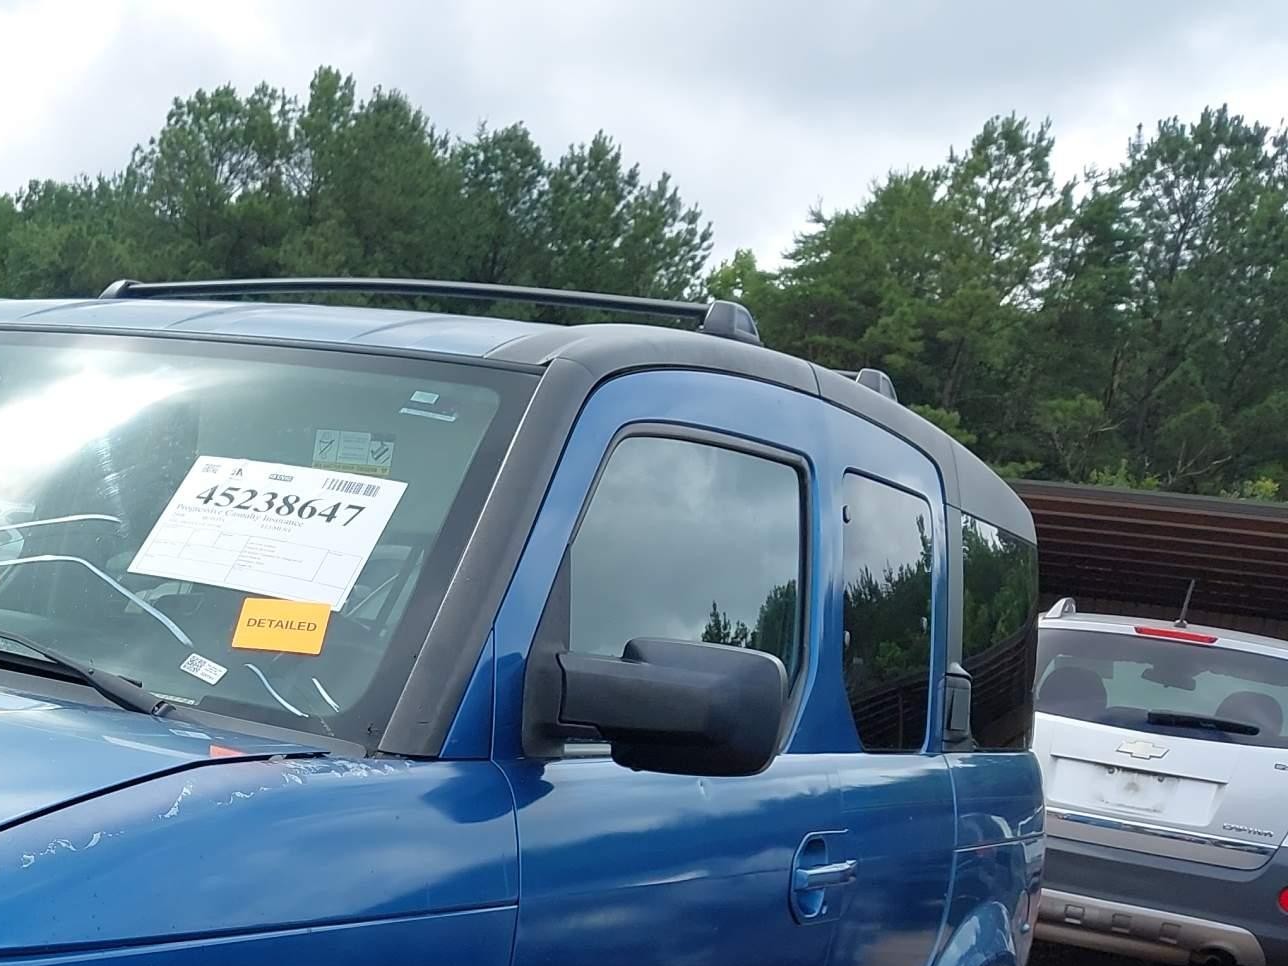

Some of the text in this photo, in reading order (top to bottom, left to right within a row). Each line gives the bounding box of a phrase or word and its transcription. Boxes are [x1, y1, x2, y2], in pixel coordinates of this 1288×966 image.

[176, 503, 223, 516] Progressive
[263, 514, 305, 528] Insurance
[196, 484, 366, 527] 45238647
[246, 618, 317, 632] DETAILED
